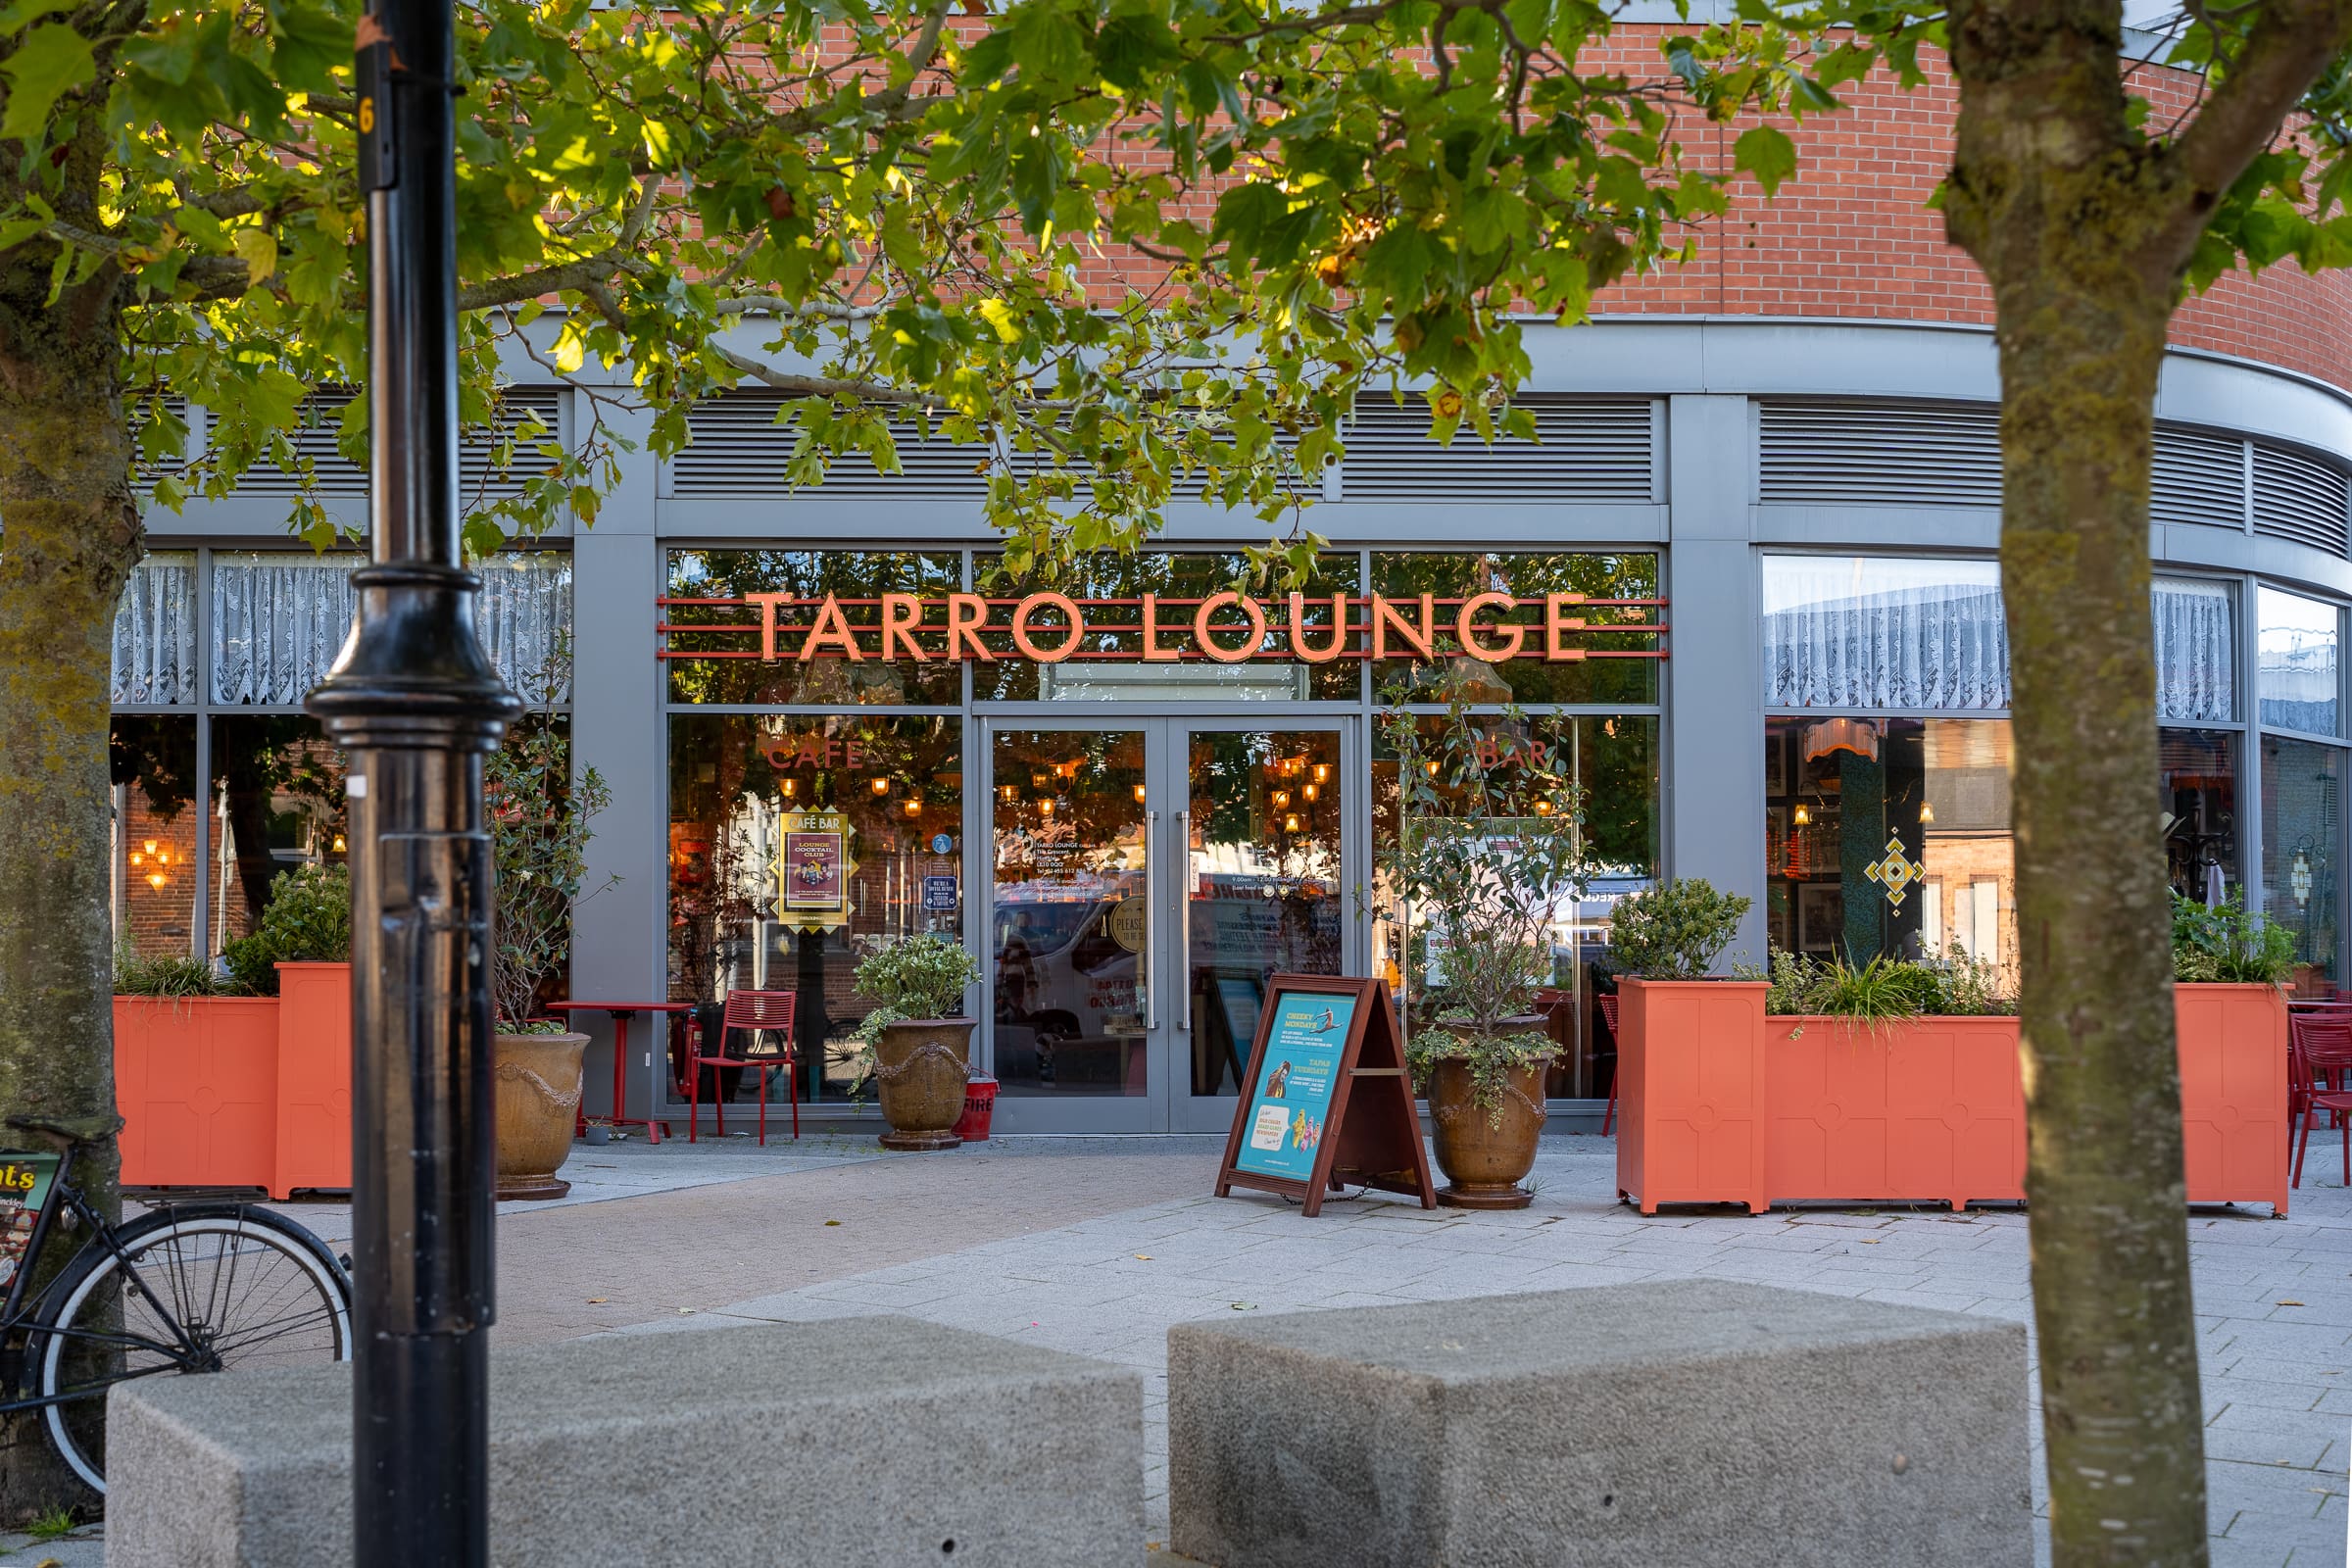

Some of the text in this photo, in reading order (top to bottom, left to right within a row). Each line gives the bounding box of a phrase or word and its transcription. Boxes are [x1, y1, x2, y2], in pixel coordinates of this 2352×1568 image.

[360, 97, 374, 133] 6
[744, 590, 1588, 663] TARRO LOUNGE
[1480, 740, 1547, 768] BAR
[789, 815, 840, 829] CAFÉ BAR
[1116, 917, 1144, 931] PLEASE
[1285, 1020, 1317, 1029] MONDAYS
[964, 1099, 992, 1112] FIRE
